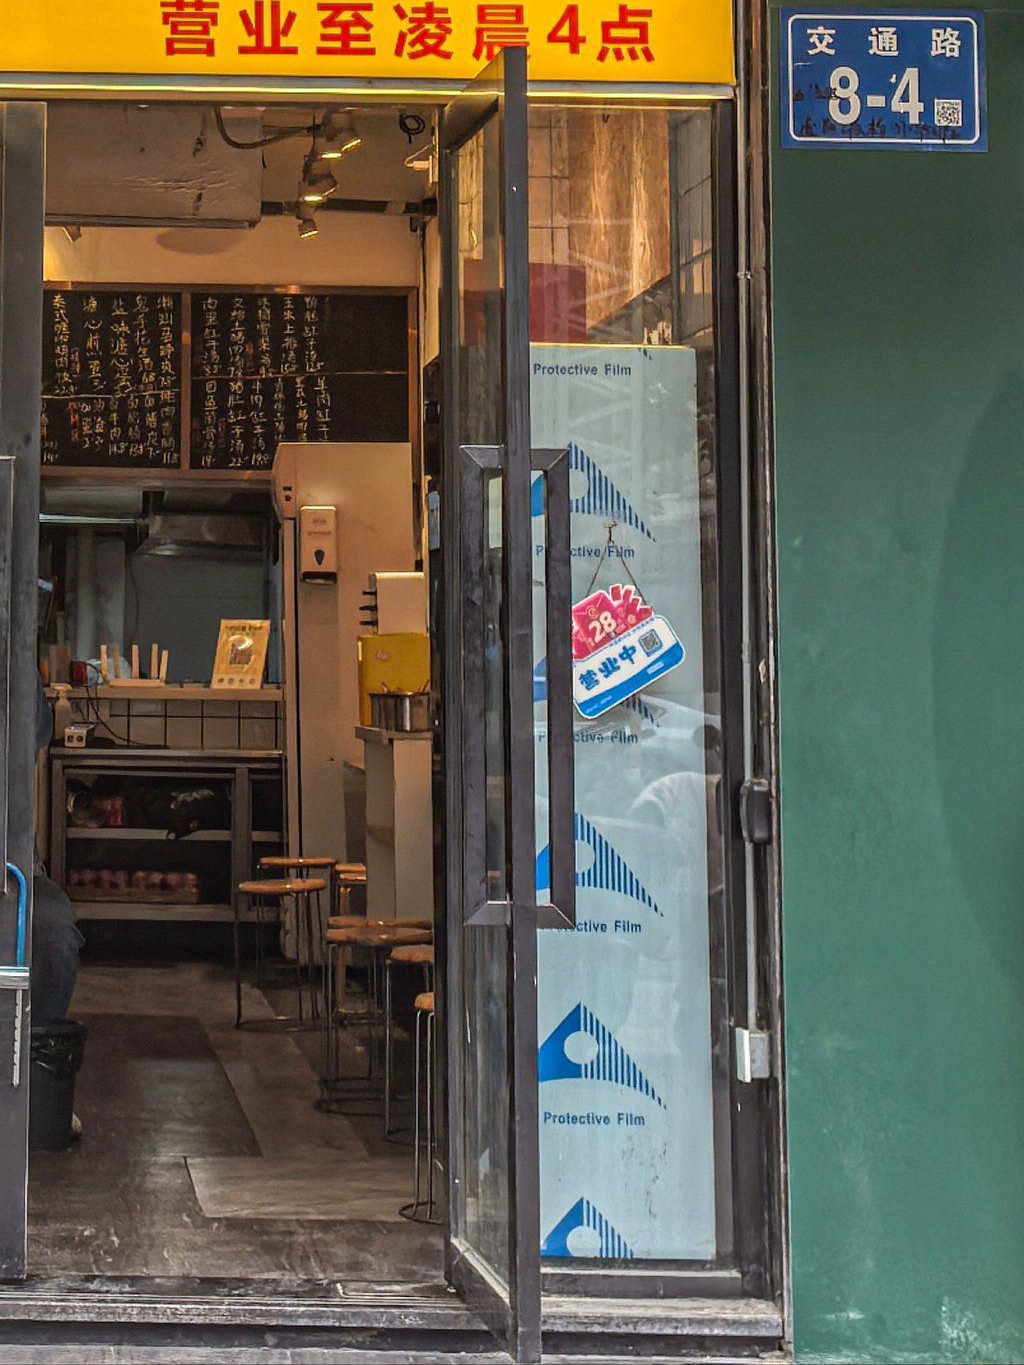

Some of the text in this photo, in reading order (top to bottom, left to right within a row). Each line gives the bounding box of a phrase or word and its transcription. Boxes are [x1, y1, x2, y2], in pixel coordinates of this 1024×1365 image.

[806, 25, 961, 58] 交通路
[828, 66, 925, 125] 8-4
[533, 363, 632, 376] Protective Film
[535, 545, 601, 557] Pctive
[588, 610, 618, 644] 28
[578, 645, 637, 691] 营业中
[614, 920, 642, 933] Film
[544, 1112, 645, 1126] Protective Film
